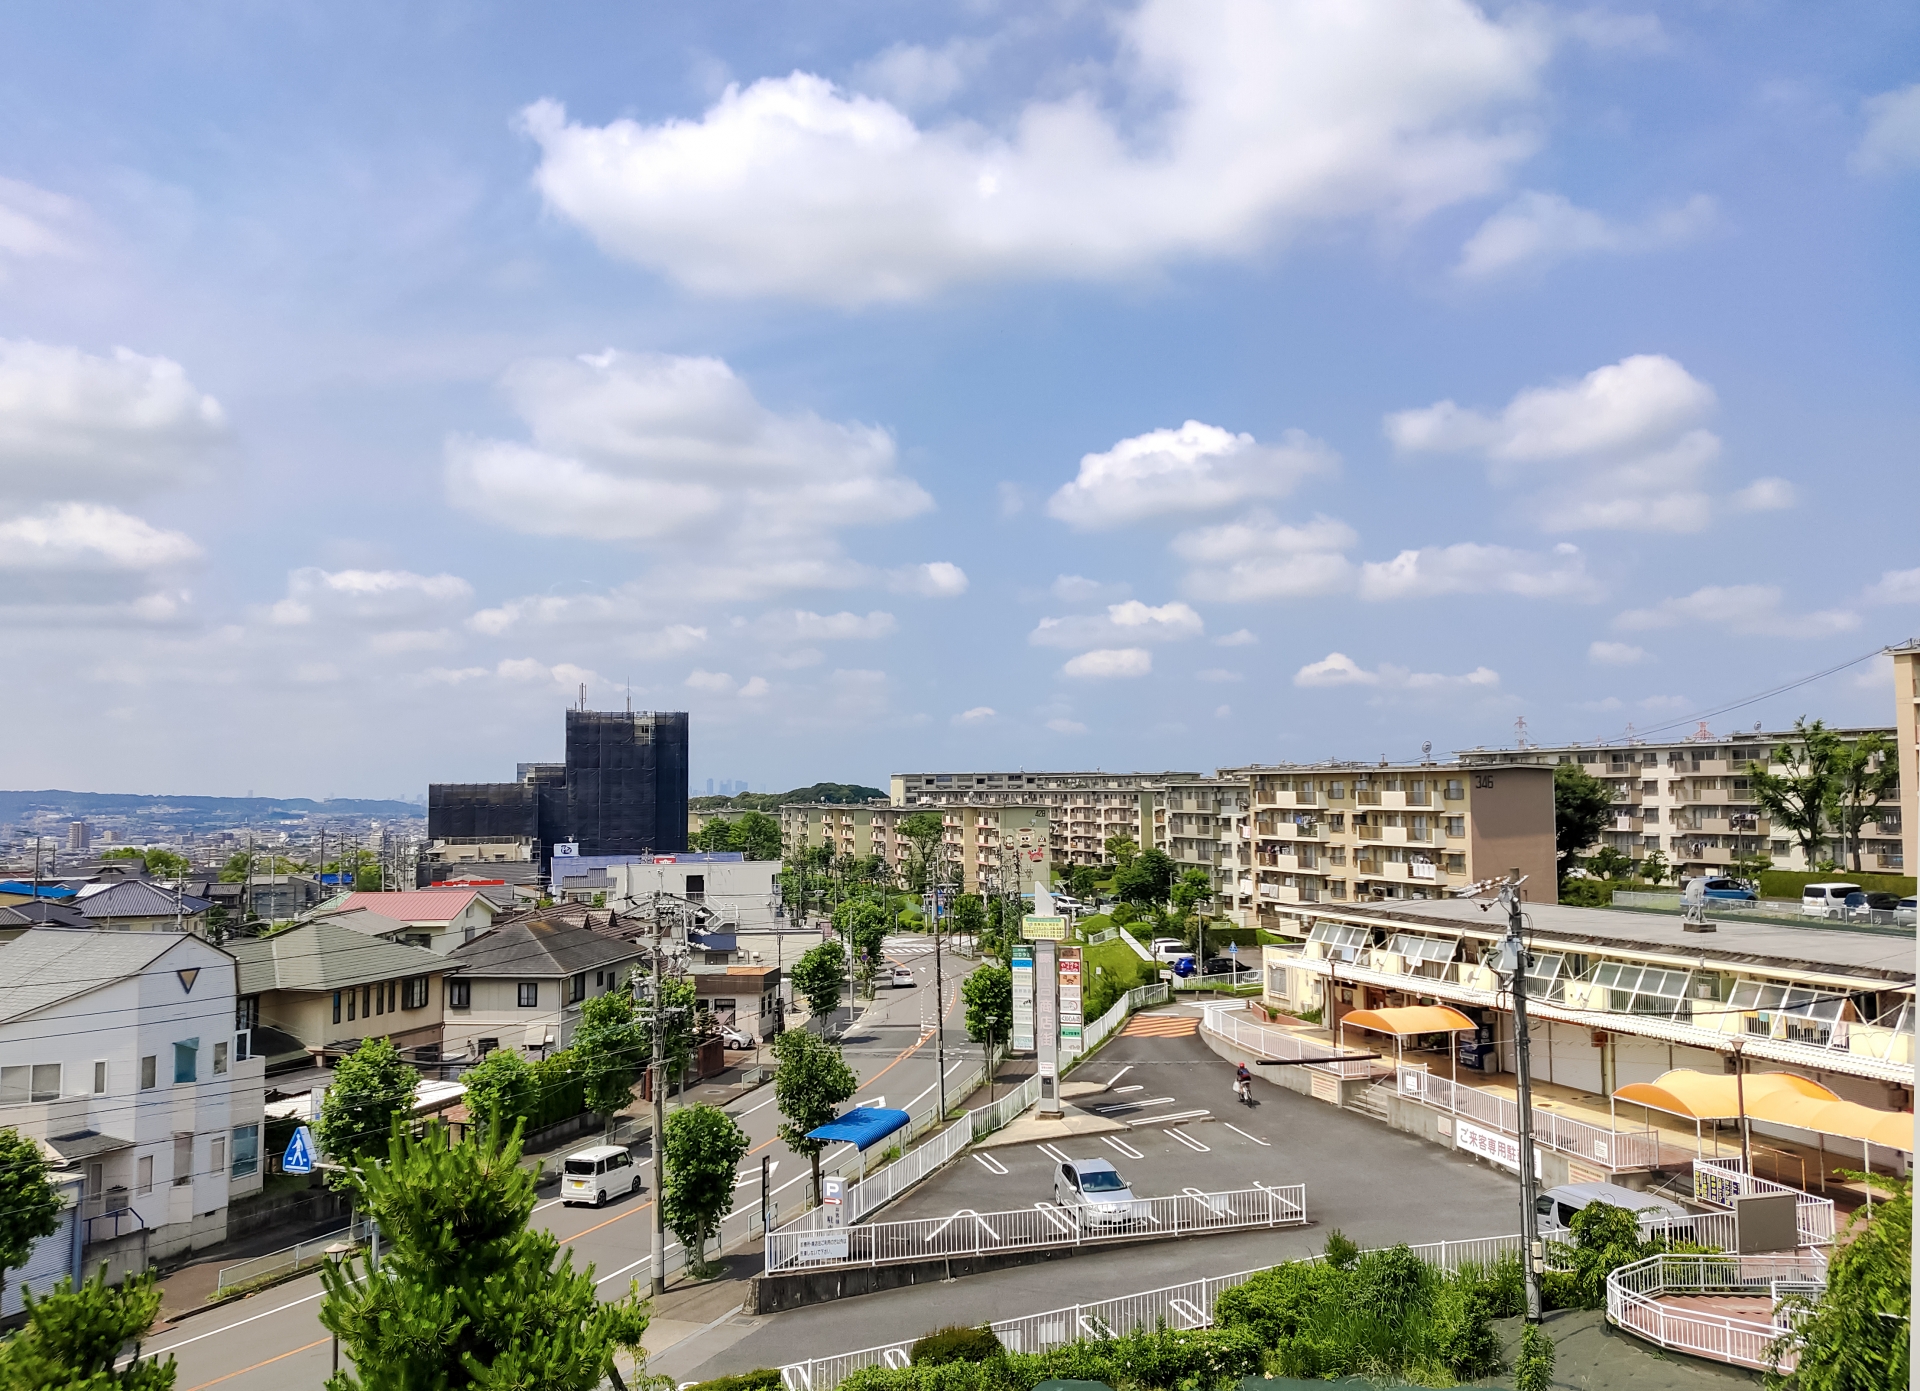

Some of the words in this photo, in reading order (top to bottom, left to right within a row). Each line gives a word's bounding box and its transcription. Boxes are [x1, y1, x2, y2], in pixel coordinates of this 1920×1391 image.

[1475, 775, 1494, 789] 346
[1460, 1127, 1537, 1171] ご来客専用駐
[826, 1182, 839, 1196] P
